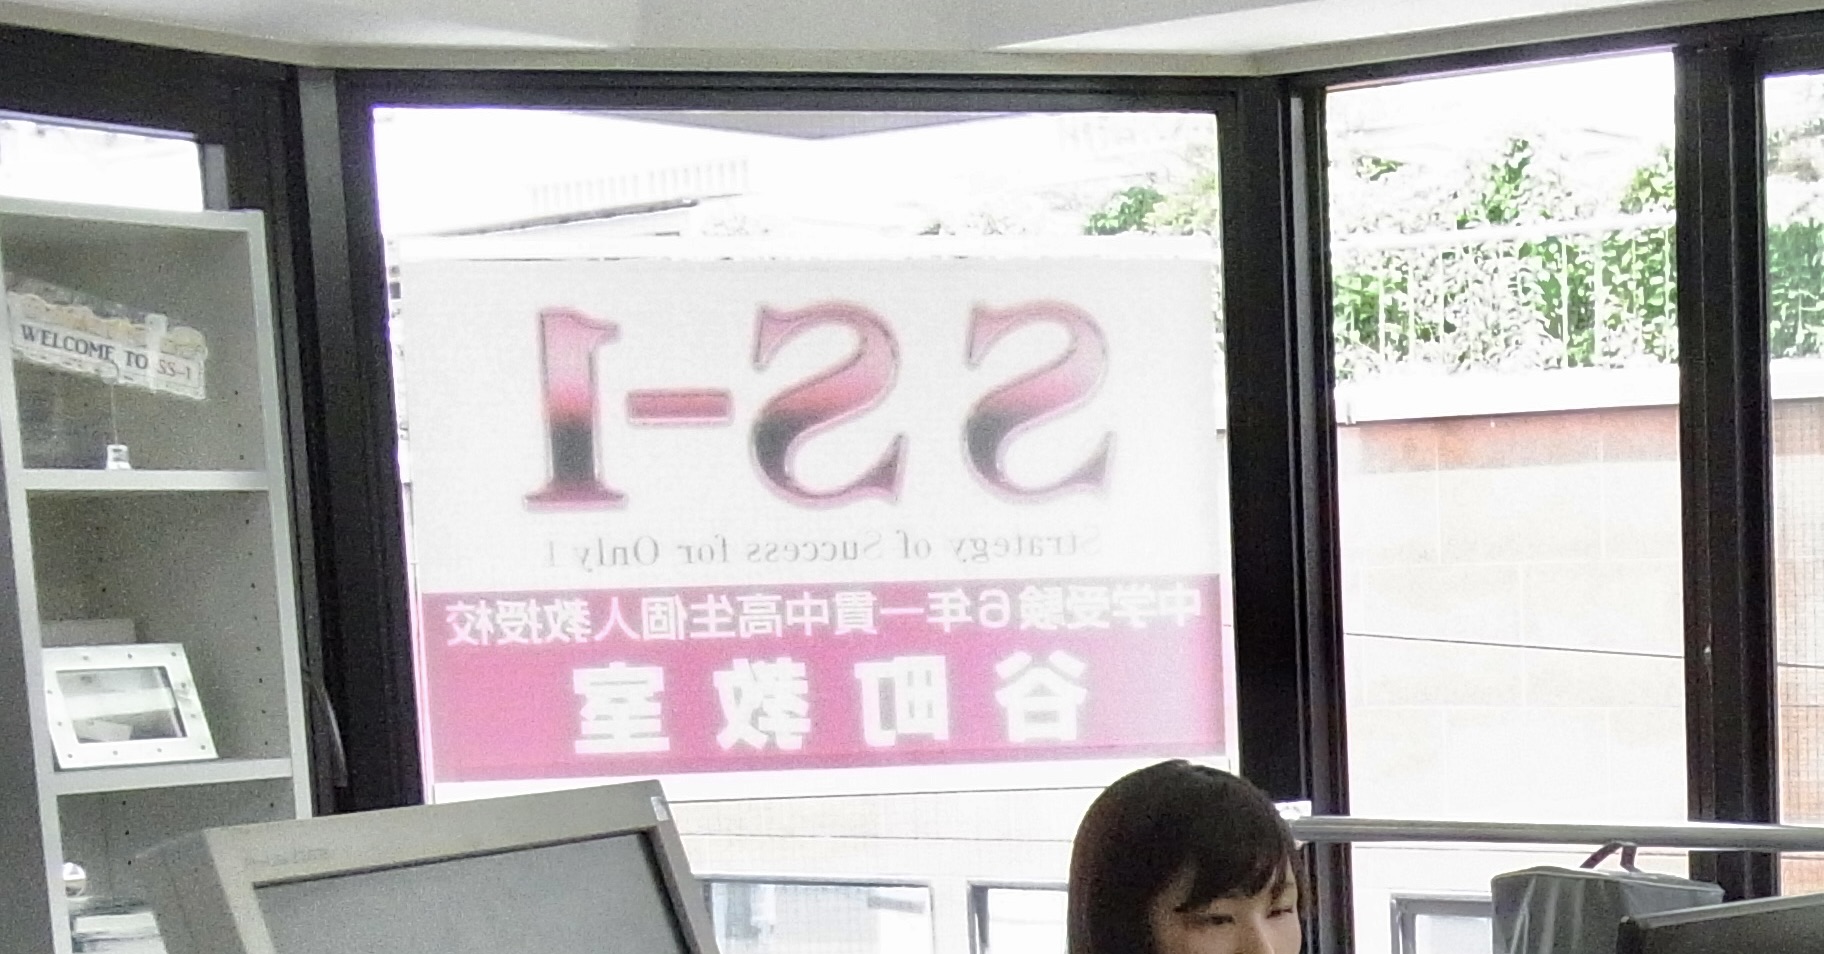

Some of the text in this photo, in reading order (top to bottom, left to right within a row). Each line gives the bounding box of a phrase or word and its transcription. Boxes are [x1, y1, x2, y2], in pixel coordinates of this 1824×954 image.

[20, 323, 192, 380] WELCOME TO SS-1
